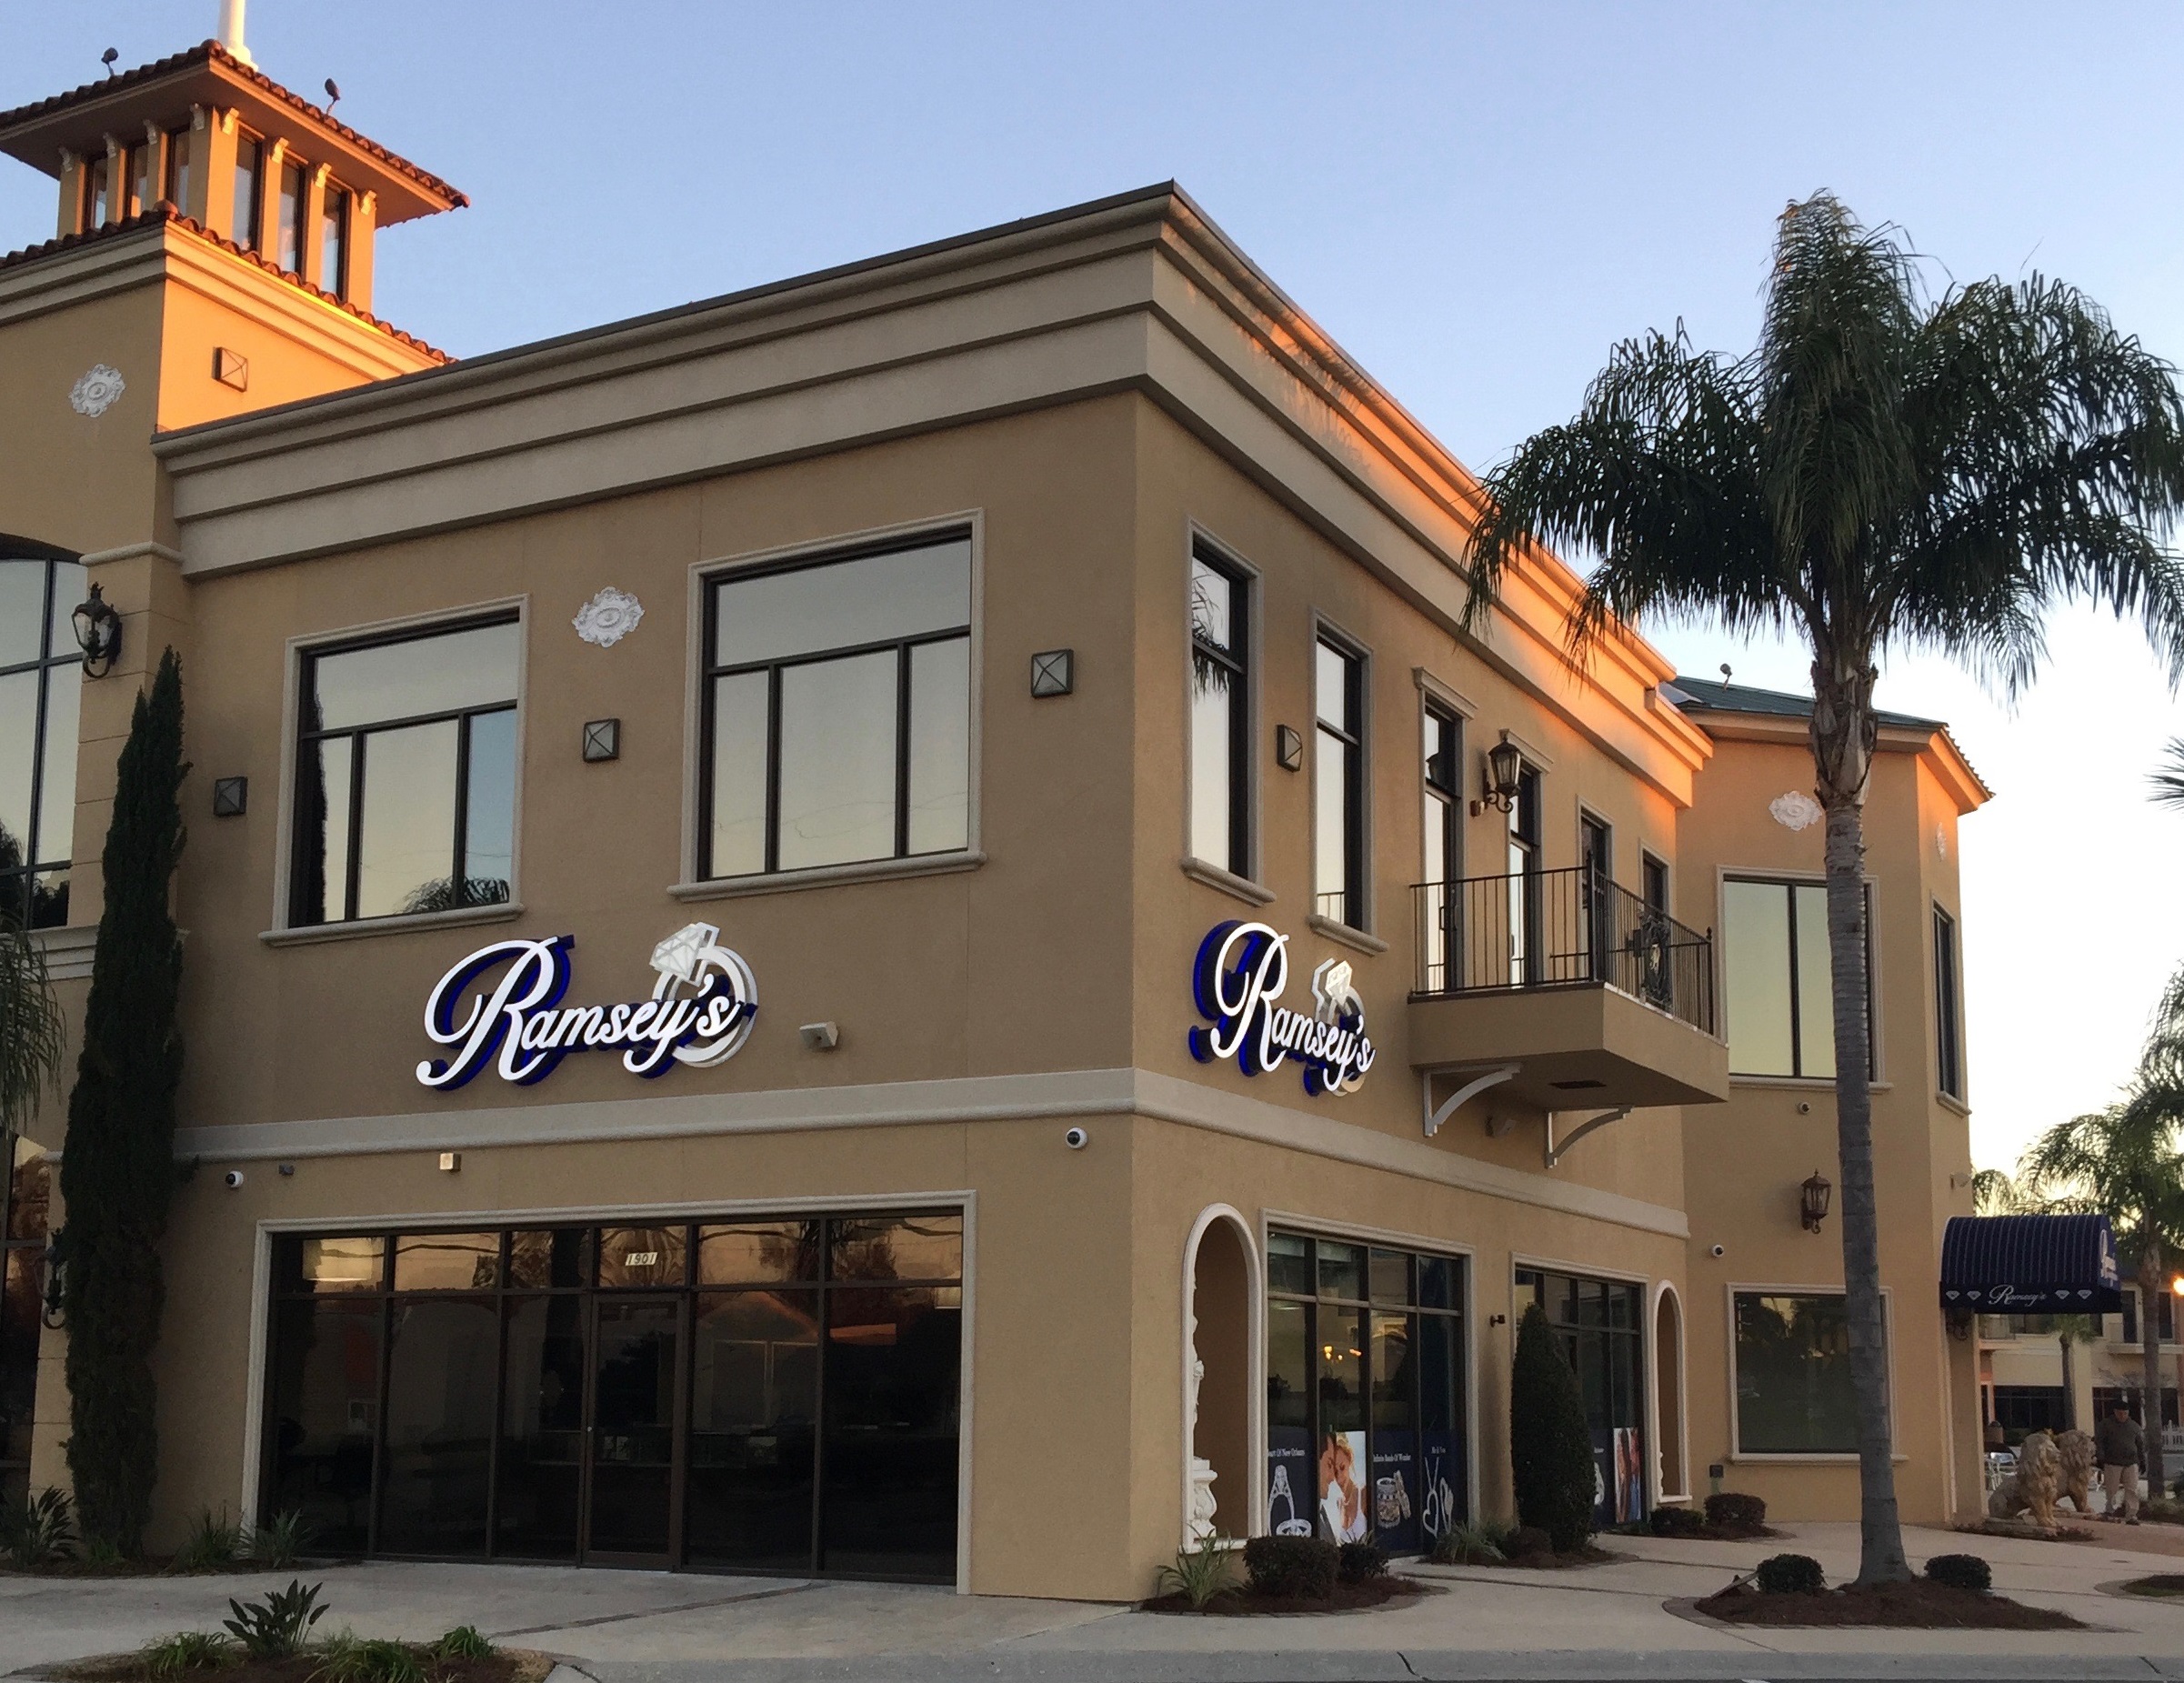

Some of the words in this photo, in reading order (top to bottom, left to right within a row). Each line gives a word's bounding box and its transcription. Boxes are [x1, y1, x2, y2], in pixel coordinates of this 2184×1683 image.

[416, 935, 746, 1087] Ramsey's
[1208, 921, 1377, 1092] Ramsey's
[627, 1253, 656, 1265] 1901
